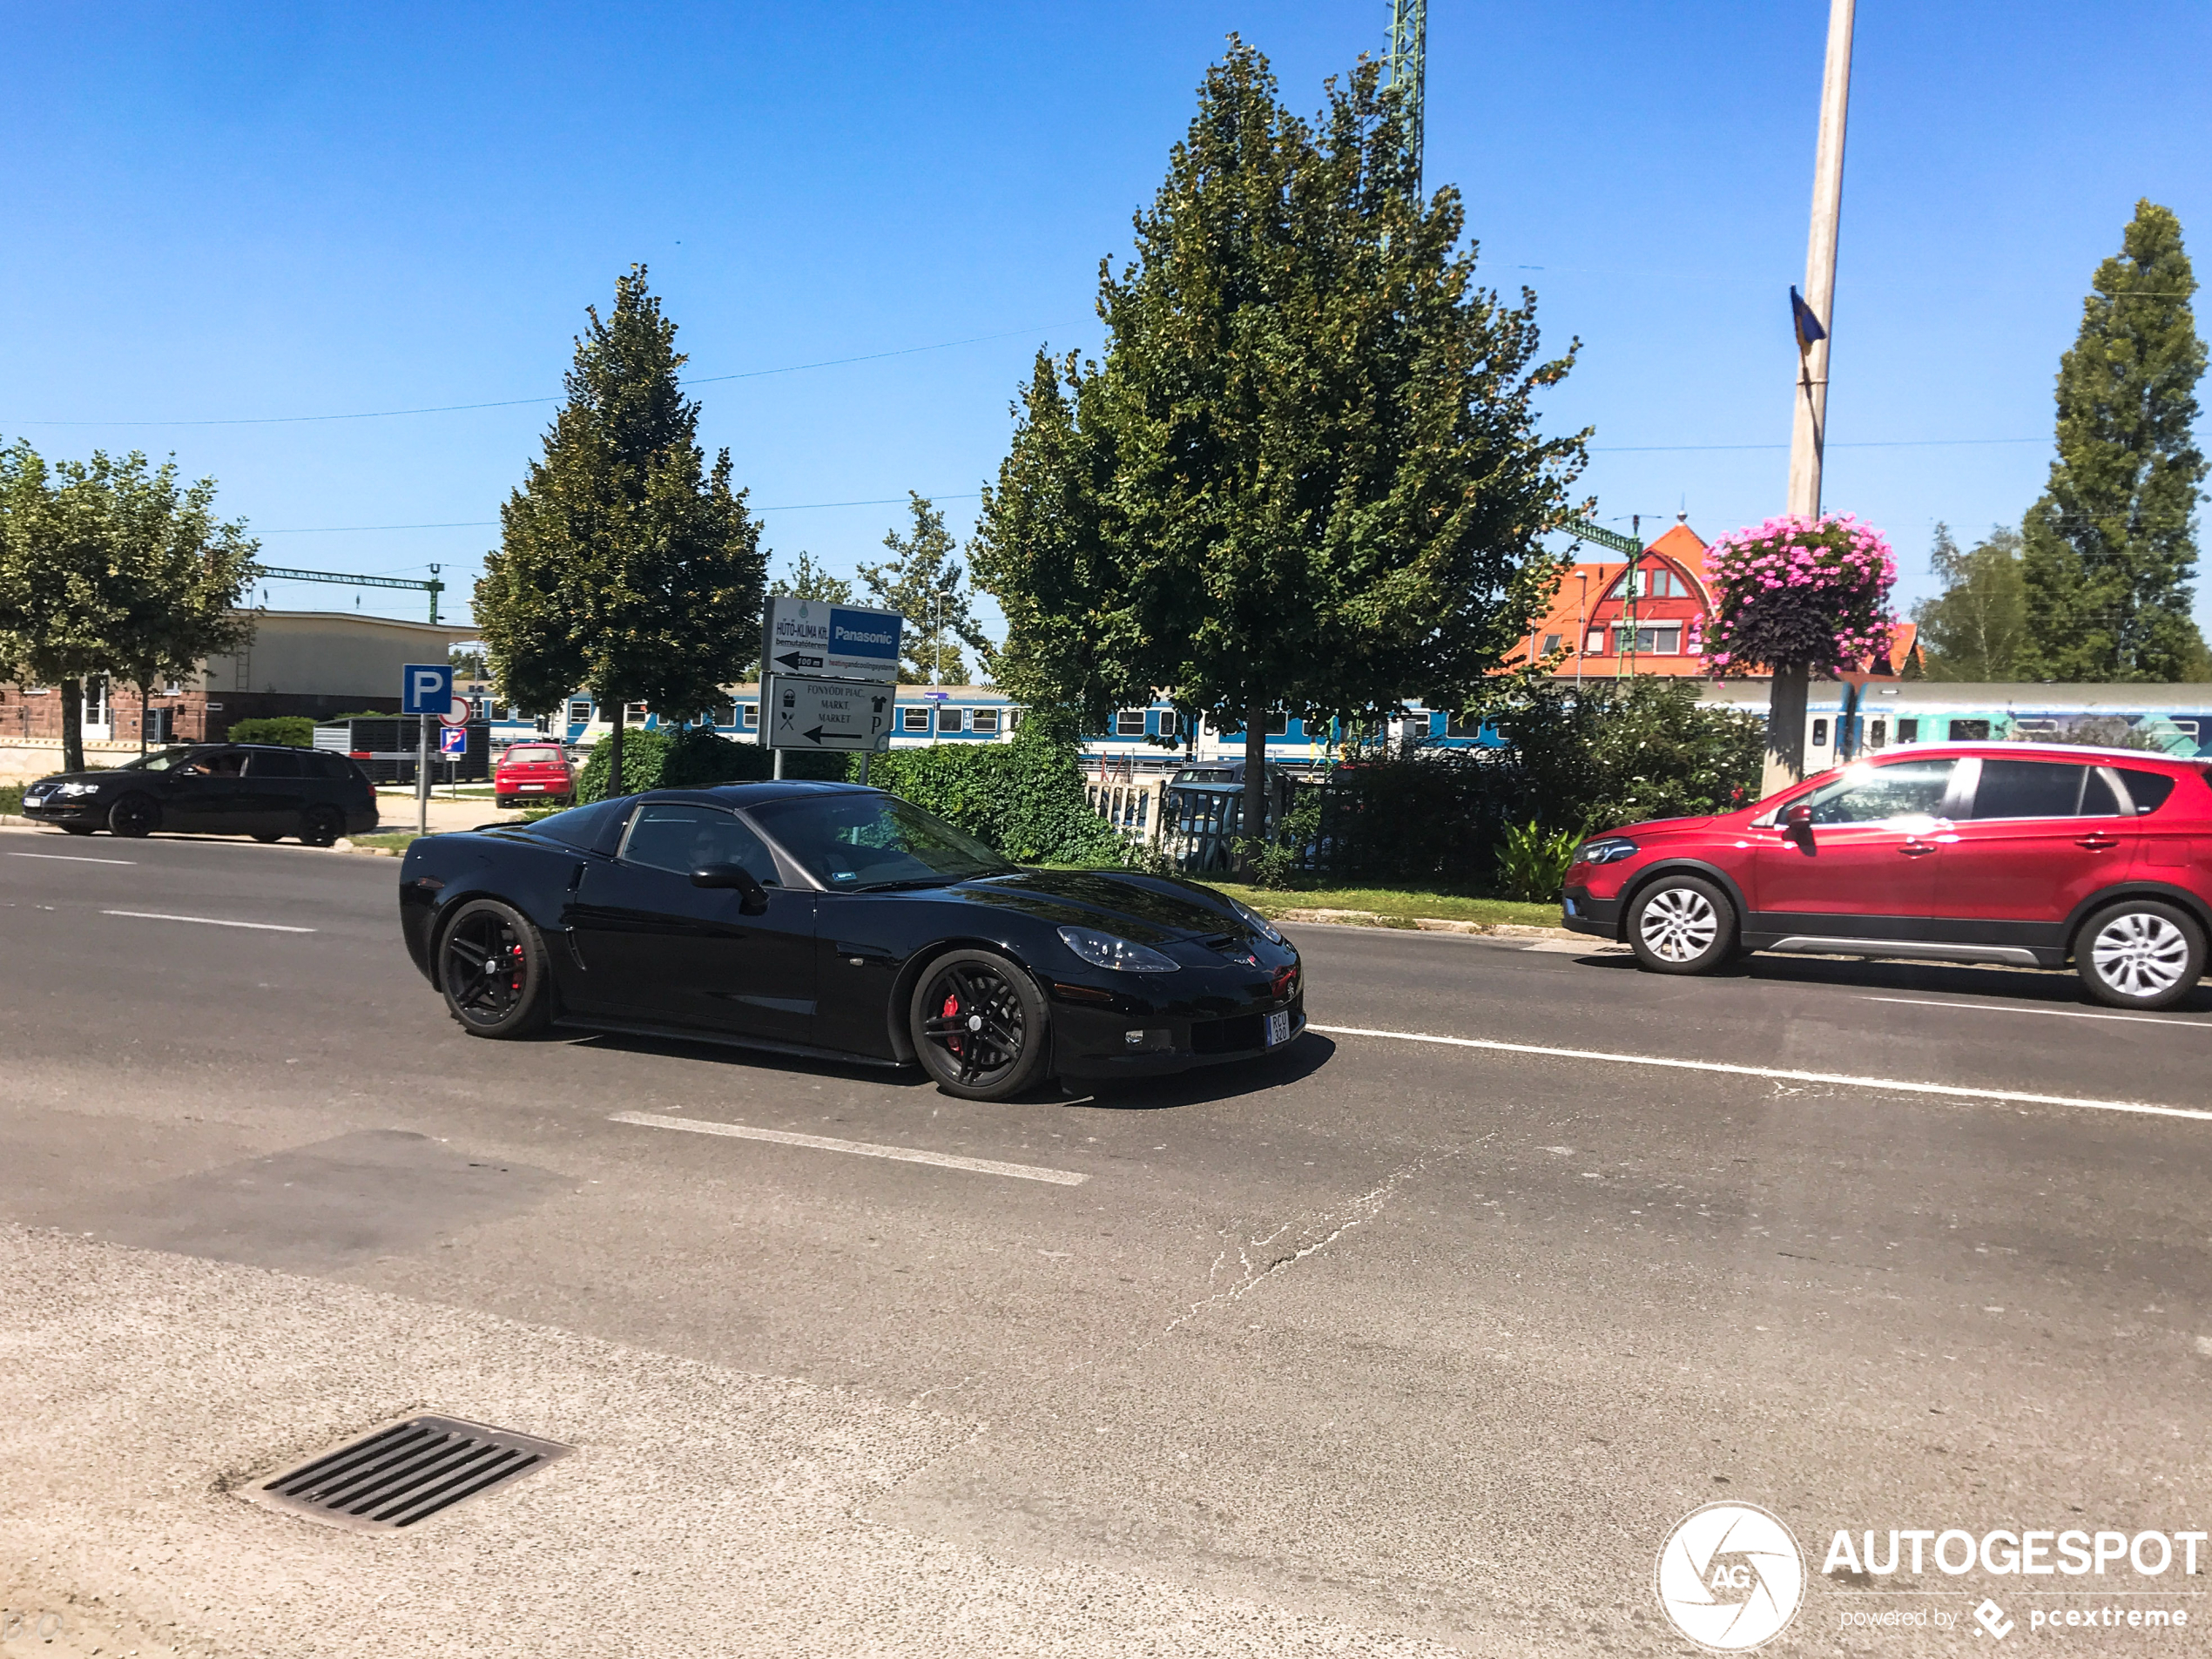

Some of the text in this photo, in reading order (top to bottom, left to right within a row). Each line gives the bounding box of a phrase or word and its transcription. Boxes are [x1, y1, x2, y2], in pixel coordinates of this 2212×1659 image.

[835, 625, 893, 644] Panasonic
[776, 637, 828, 650] bemutatóterem
[829, 659, 895, 672] heatingandcoolingsystems
[413, 671, 443, 708] P
[807, 685, 844, 696] FONYÓDI
[819, 713, 852, 723] MARKET
[871, 716, 881, 734] P
[446, 732, 462, 750] P
[1272, 1013, 1286, 1028] RCU
[1275, 1027, 1286, 1042] 320
